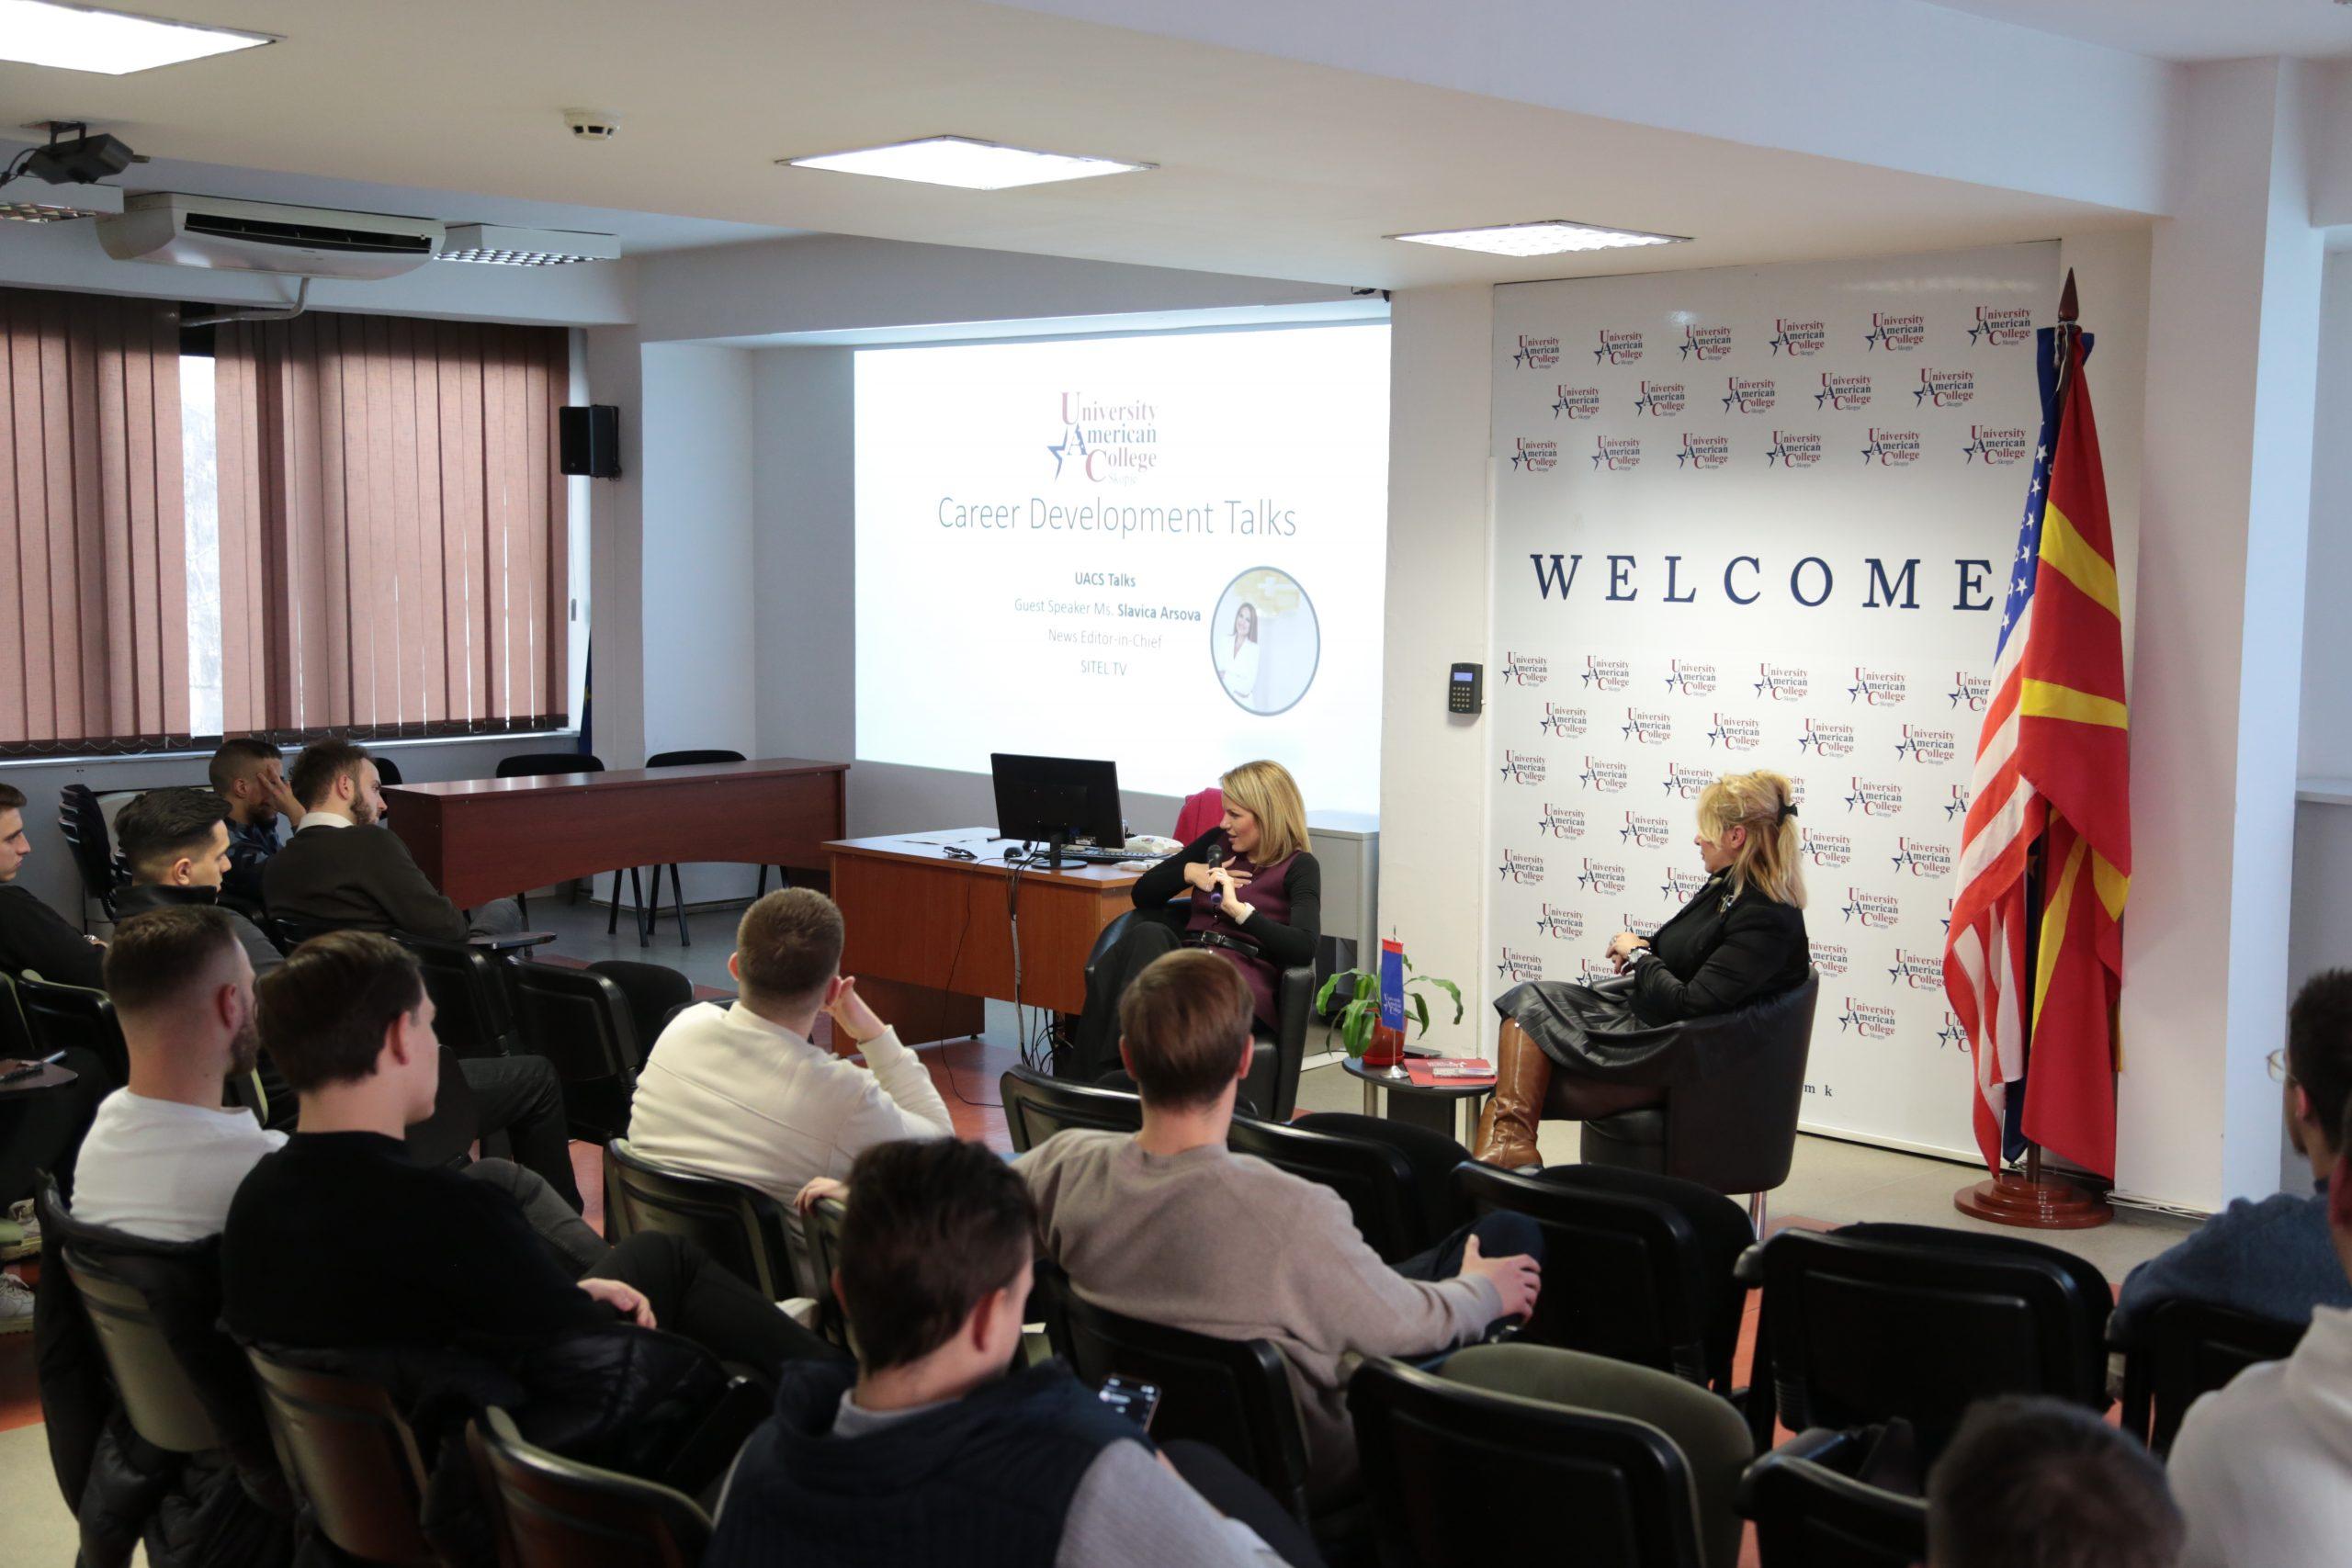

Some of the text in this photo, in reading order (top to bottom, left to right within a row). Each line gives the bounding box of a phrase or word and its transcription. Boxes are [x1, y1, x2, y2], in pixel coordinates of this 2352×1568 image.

[1872, 312, 1924, 327] University
[1975, 305, 2030, 321] University
[1686, 324, 1731, 338] University
[1776, 318, 1825, 333] University
[1875, 324, 1923, 340] American
[1977, 318, 2029, 333] American
[1519, 334, 1560, 348] University
[1600, 330, 1643, 344] University
[1688, 335, 1731, 350] American
[1779, 330, 1824, 344] American
[1885, 333, 1924, 350] College
[1988, 328, 2029, 344] College
[1521, 345, 1559, 359] American
[1602, 341, 1643, 355] American
[1697, 344, 1731, 360] College
[1788, 339, 1825, 355] College
[1529, 355, 1559, 369] College
[1611, 349, 1643, 365] College
[1822, 372, 1872, 387] University
[1921, 367, 1974, 383] University
[1641, 380, 1685, 394] University
[1729, 377, 1776, 390] University
[1924, 380, 1973, 395] American
[1558, 385, 1600, 398] University
[1731, 389, 1775, 402] American
[1825, 384, 1871, 399] American
[1934, 389, 1973, 406] College
[1560, 396, 1600, 409] American
[1644, 392, 1685, 406] American
[1740, 398, 1776, 413] College
[1835, 394, 1871, 410] College
[1061, 391, 1158, 425] University
[1568, 404, 1600, 419] College
[1652, 401, 1685, 416] College
[1773, 430, 1822, 445] University
[1870, 427, 1920, 442] University
[1971, 424, 2026, 439] University
[1067, 423, 1157, 456] American
[1517, 437, 1558, 451] University
[1598, 435, 1641, 448] University
[1683, 433, 1729, 446] University
[1973, 437, 2025, 452] American
[1600, 446, 1640, 460] American
[1686, 445, 1728, 458] American
[1776, 442, 1821, 457] American
[1871, 440, 1919, 454] American
[1520, 449, 1557, 461] American
[1694, 454, 1728, 468] College
[1785, 452, 1821, 467] College
[1882, 449, 1920, 466] College
[1984, 447, 2025, 464] College
[1085, 447, 1157, 483] College
[1527, 457, 1557, 471] College
[1609, 456, 1641, 470] College
[938, 496, 1296, 539] Career Development Talks
[1075, 572, 1136, 587] UACS Talks
[1530, 554, 1994, 611] WELCOME
[1014, 598, 1201, 621] Guest Speaker Ms. Slavica Arsova
[1048, 628, 1162, 649] News Editor-in-Chief
[1508, 651, 1548, 667] University
[1588, 655, 1630, 671] University
[1081, 660, 1127, 676] SITEL TV
[1510, 663, 1547, 676] American
[1589, 668, 1629, 680] American
[1671, 659, 1716, 675] University
[1760, 663, 1808, 680] University
[1518, 672, 1548, 686] College
[1674, 671, 1716, 684] American
[1763, 676, 1807, 689] American
[1855, 667, 1905, 684] University
[1598, 677, 1630, 691] College
[1682, 682, 1716, 695] College
[1858, 681, 1905, 694] American
[1772, 686, 1808, 700] College
[1868, 691, 1905, 705] College
[1546, 703, 1588, 718] University
[1628, 707, 1671, 724] University
[1548, 715, 1587, 727] American
[1630, 720, 1671, 732] American
[1714, 713, 1760, 729] University
[1806, 718, 1855, 736] University
[1556, 724, 1588, 738] College
[1639, 729, 1671, 743] College
[1717, 726, 1759, 739] American
[1808, 731, 1854, 745] American
[1903, 724, 1955, 742] University
[1725, 736, 1760, 750] College
[1817, 742, 1854, 756] College
[1905, 738, 1954, 751] American
[1506, 750, 1546, 766] University
[1916, 749, 1954, 763] College
[1509, 761, 1545, 773] American
[1586, 756, 1628, 773] University
[1669, 762, 1714, 780] University
[1516, 772, 1546, 784] College
[1588, 768, 1627, 781] American
[1596, 778, 1627, 792] College
[1852, 777, 1902, 795] University
[1855, 790, 1902, 804] American
[1544, 803, 1586, 819] University
[1864, 801, 1902, 816] College
[1546, 816, 1585, 828] American
[1626, 811, 1669, 829] University
[1555, 825, 1585, 839] College
[1628, 823, 1668, 836] American
[1636, 833, 1668, 847] College
[1803, 828, 1851, 846] University
[1805, 841, 1850, 854] American
[1899, 837, 1951, 856] University
[1505, 849, 1544, 866] University
[1815, 852, 1851, 866] College
[1902, 851, 1951, 864] American
[1507, 861, 1544, 874] American
[1584, 858, 1625, 875] University
[1912, 862, 1951, 876] College
[1514, 871, 1544, 884] College
[1586, 870, 1625, 883] American
[1667, 867, 1708, 886] Universit
[1594, 880, 1625, 894] College
[1849, 887, 1899, 908] University
[1543, 903, 1584, 921] University
[1851, 901, 1898, 915] American
[1544, 916, 1583, 928] American
[1861, 912, 1898, 927] College
[1553, 926, 1583, 939] College
[1808, 936, 1849, 956] niversity
[1503, 947, 1543, 965] University
[1808, 950, 1848, 964] merican
[1896, 949, 1943, 970] Universit
[1505, 960, 1543, 972] American
[1513, 969, 1543, 982] College
[1846, 998, 1895, 1019] University
[1849, 1011, 1894, 1025] American
[1858, 1022, 1895, 1037] College
